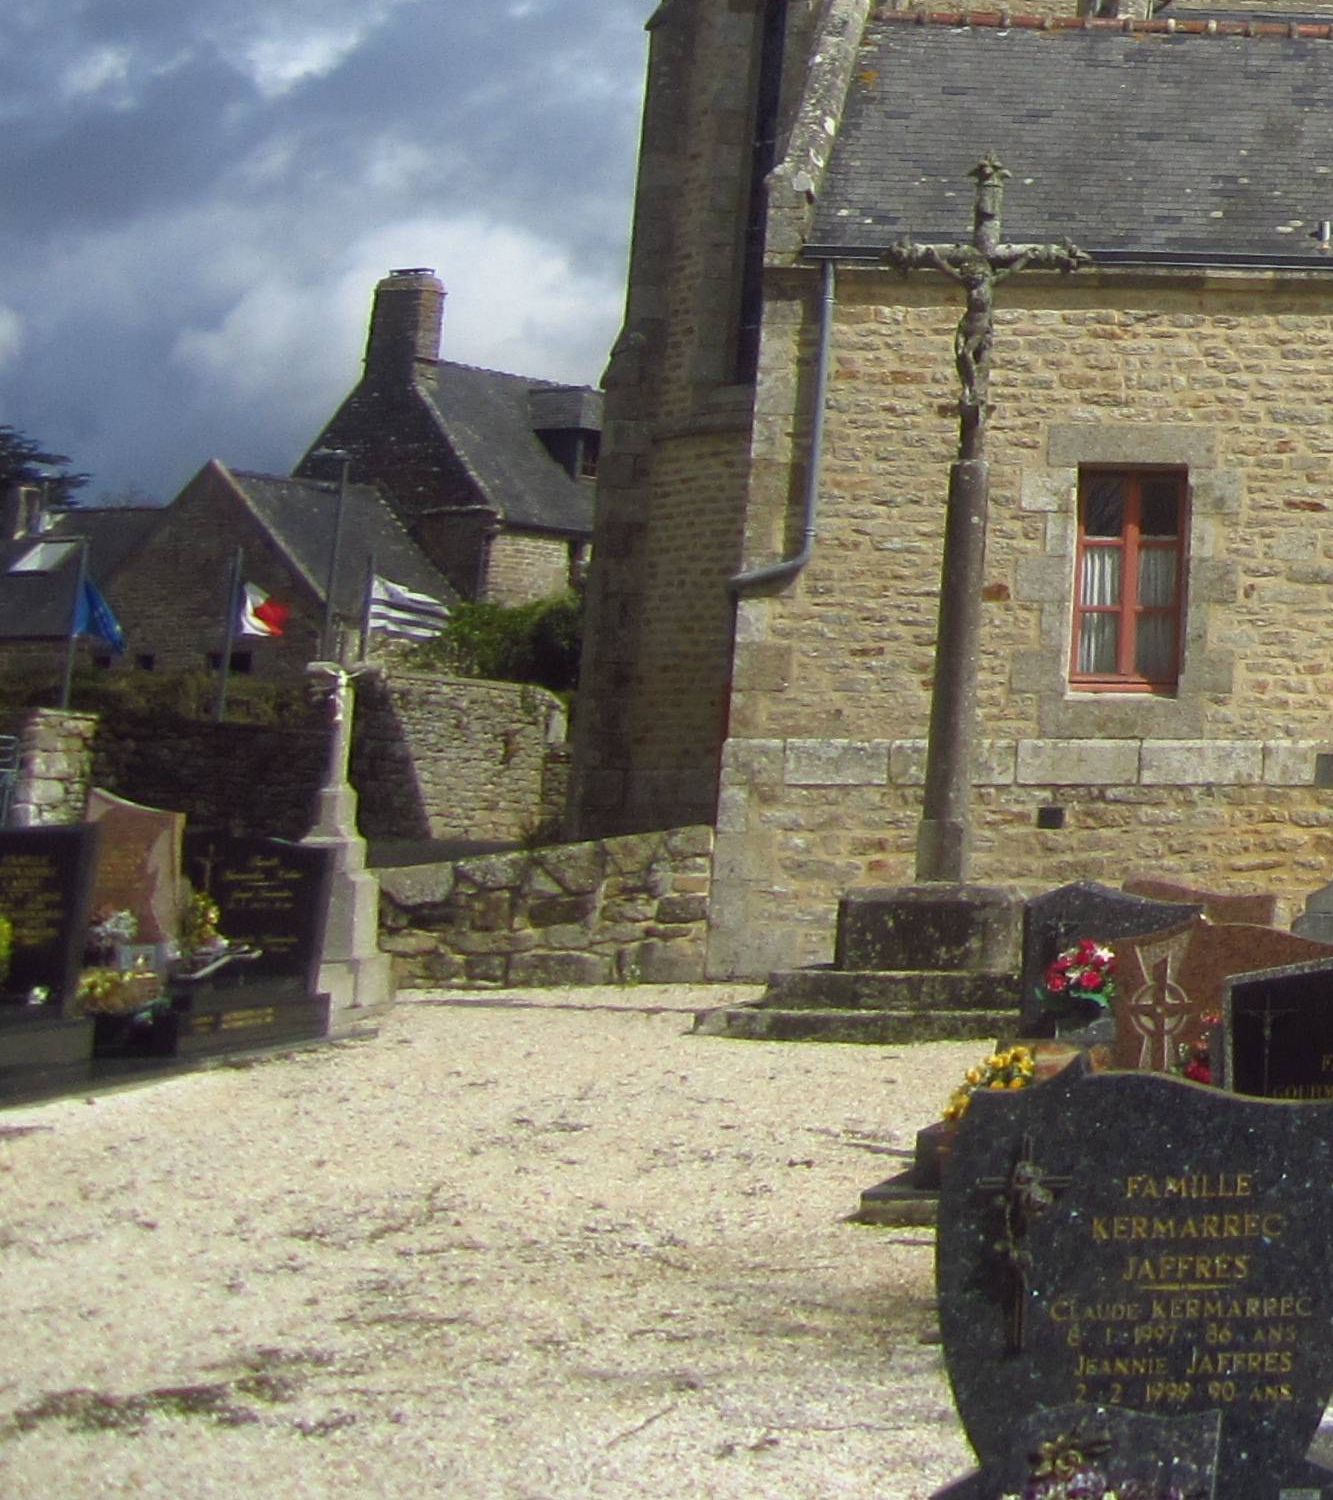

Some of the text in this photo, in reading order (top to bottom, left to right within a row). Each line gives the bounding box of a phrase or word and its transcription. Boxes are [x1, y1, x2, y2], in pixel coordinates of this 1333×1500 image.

[1126, 1173, 1254, 1199] FAMILLE
[1092, 1213, 1284, 1240] KERMARREC
[1122, 1255, 1251, 1281] JAFFRES
[1050, 1297, 1313, 1322] CLAUDE KERMARREC
[1205, 1322, 1233, 1344] 86
[1253, 1324, 1297, 1344] ANS
[1075, 1350, 1293, 1377] JEANNIE JAFFRES
[1208, 1380, 1236, 1402] 90
[1251, 1383, 1293, 1402] ANS
